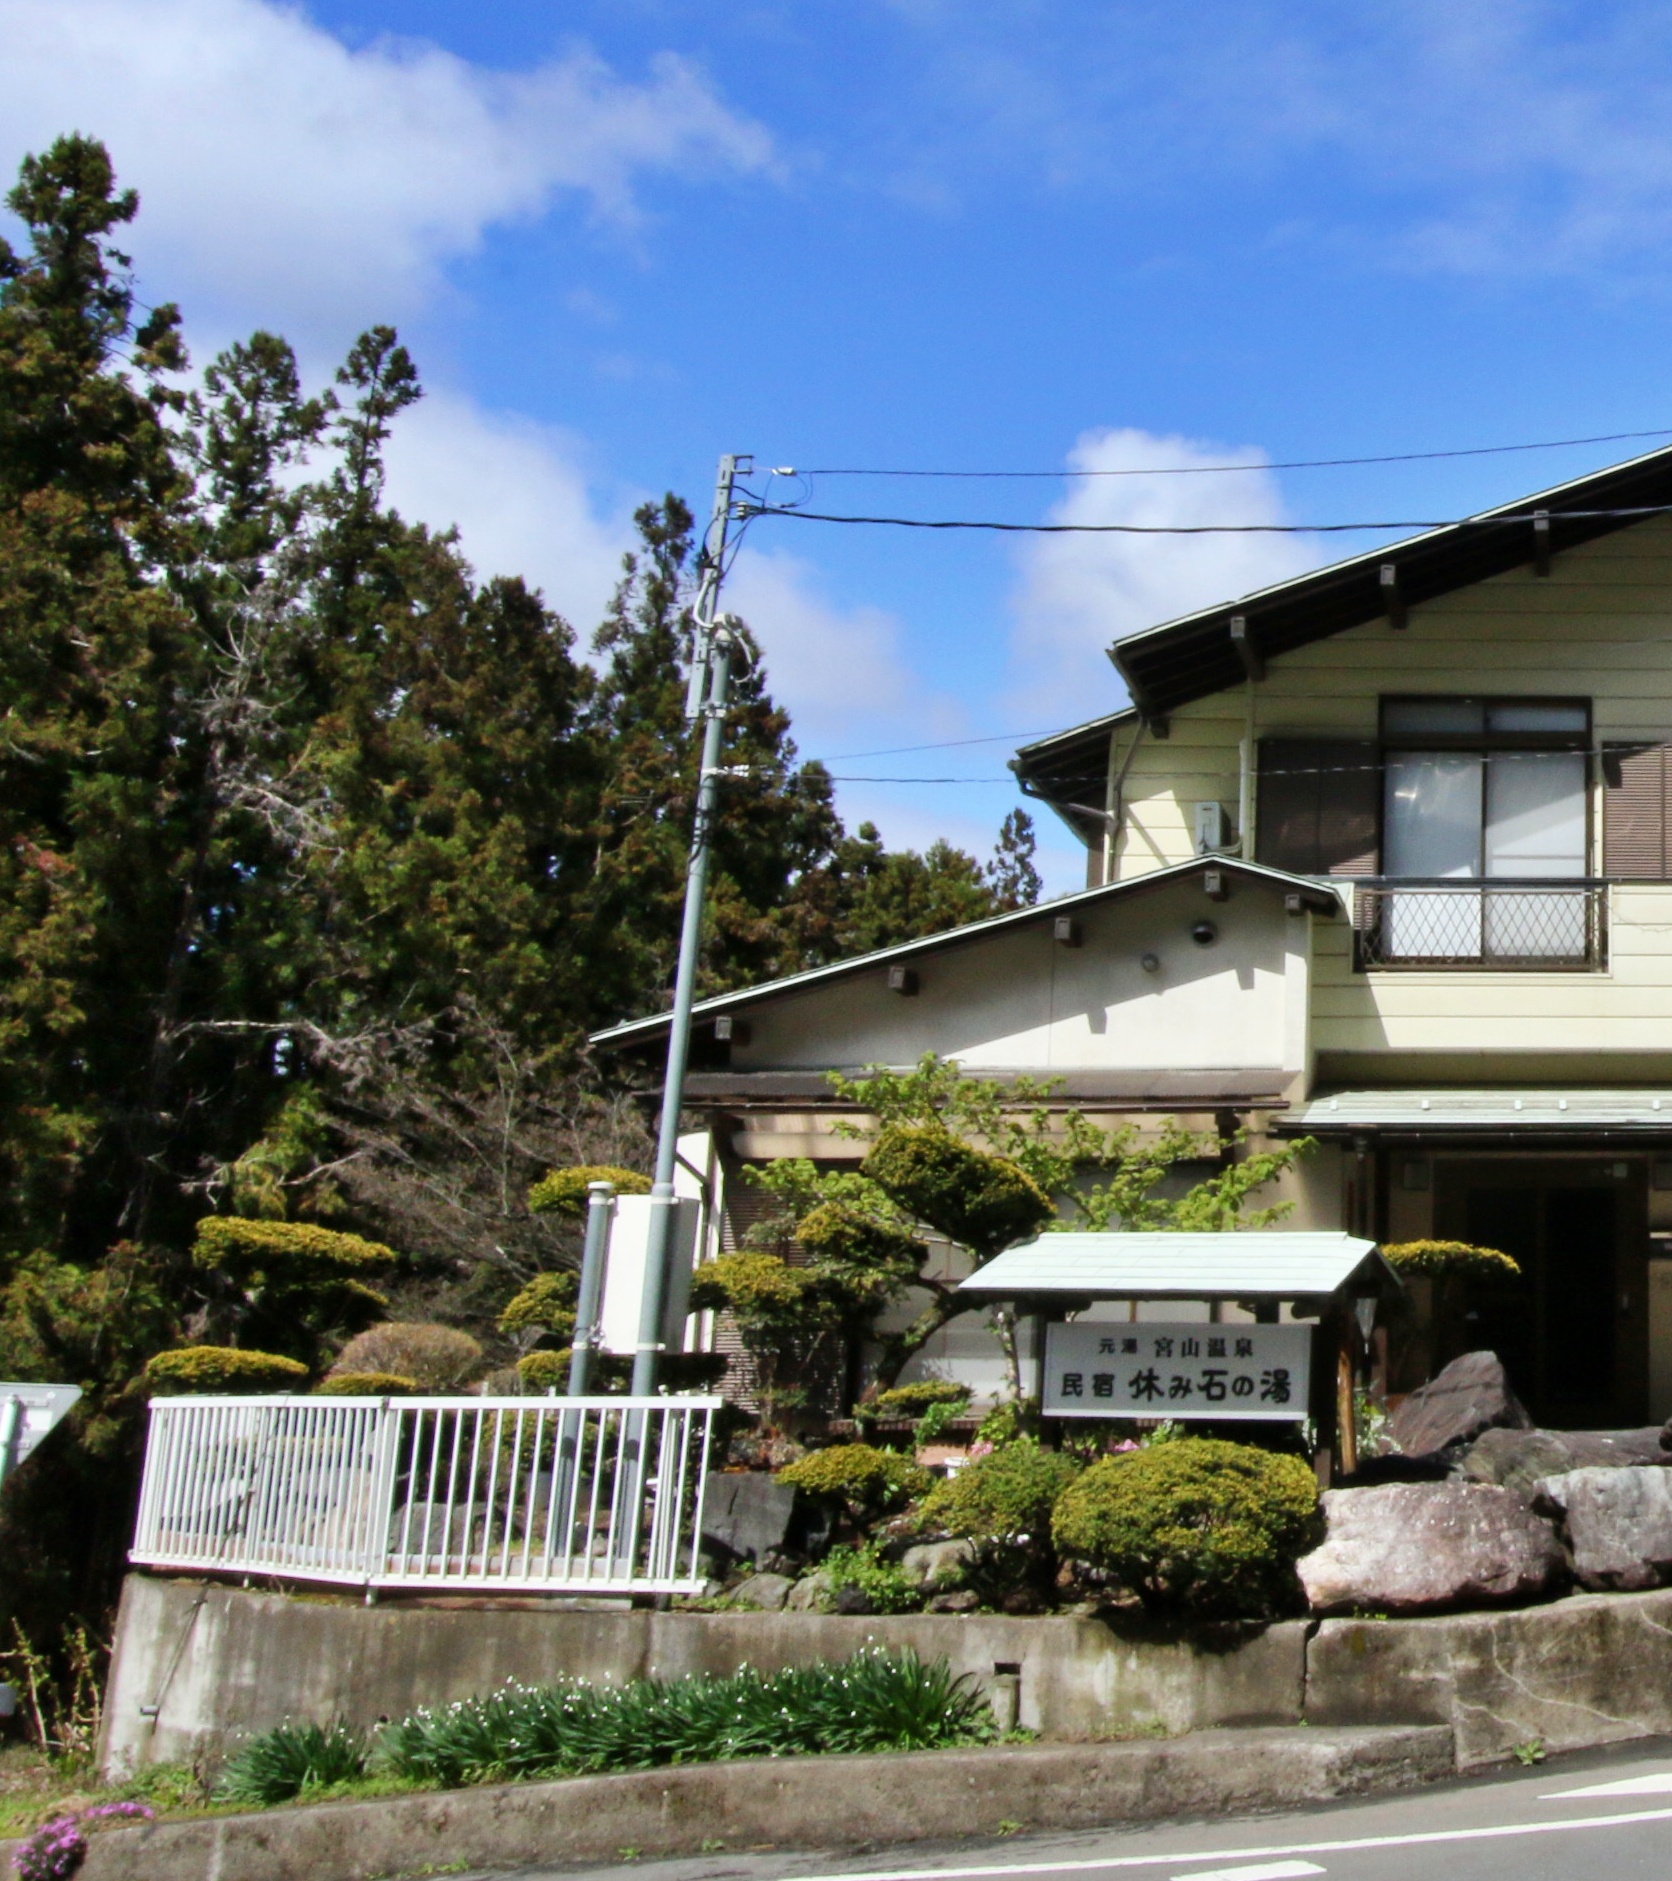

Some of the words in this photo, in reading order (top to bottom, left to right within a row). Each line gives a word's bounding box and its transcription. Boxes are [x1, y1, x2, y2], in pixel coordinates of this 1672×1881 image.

[1154, 1336, 1254, 1359] 宮山温泉
[1061, 1373, 1115, 1398] 民宿
[1128, 1368, 1292, 1404] 休み石の湯
